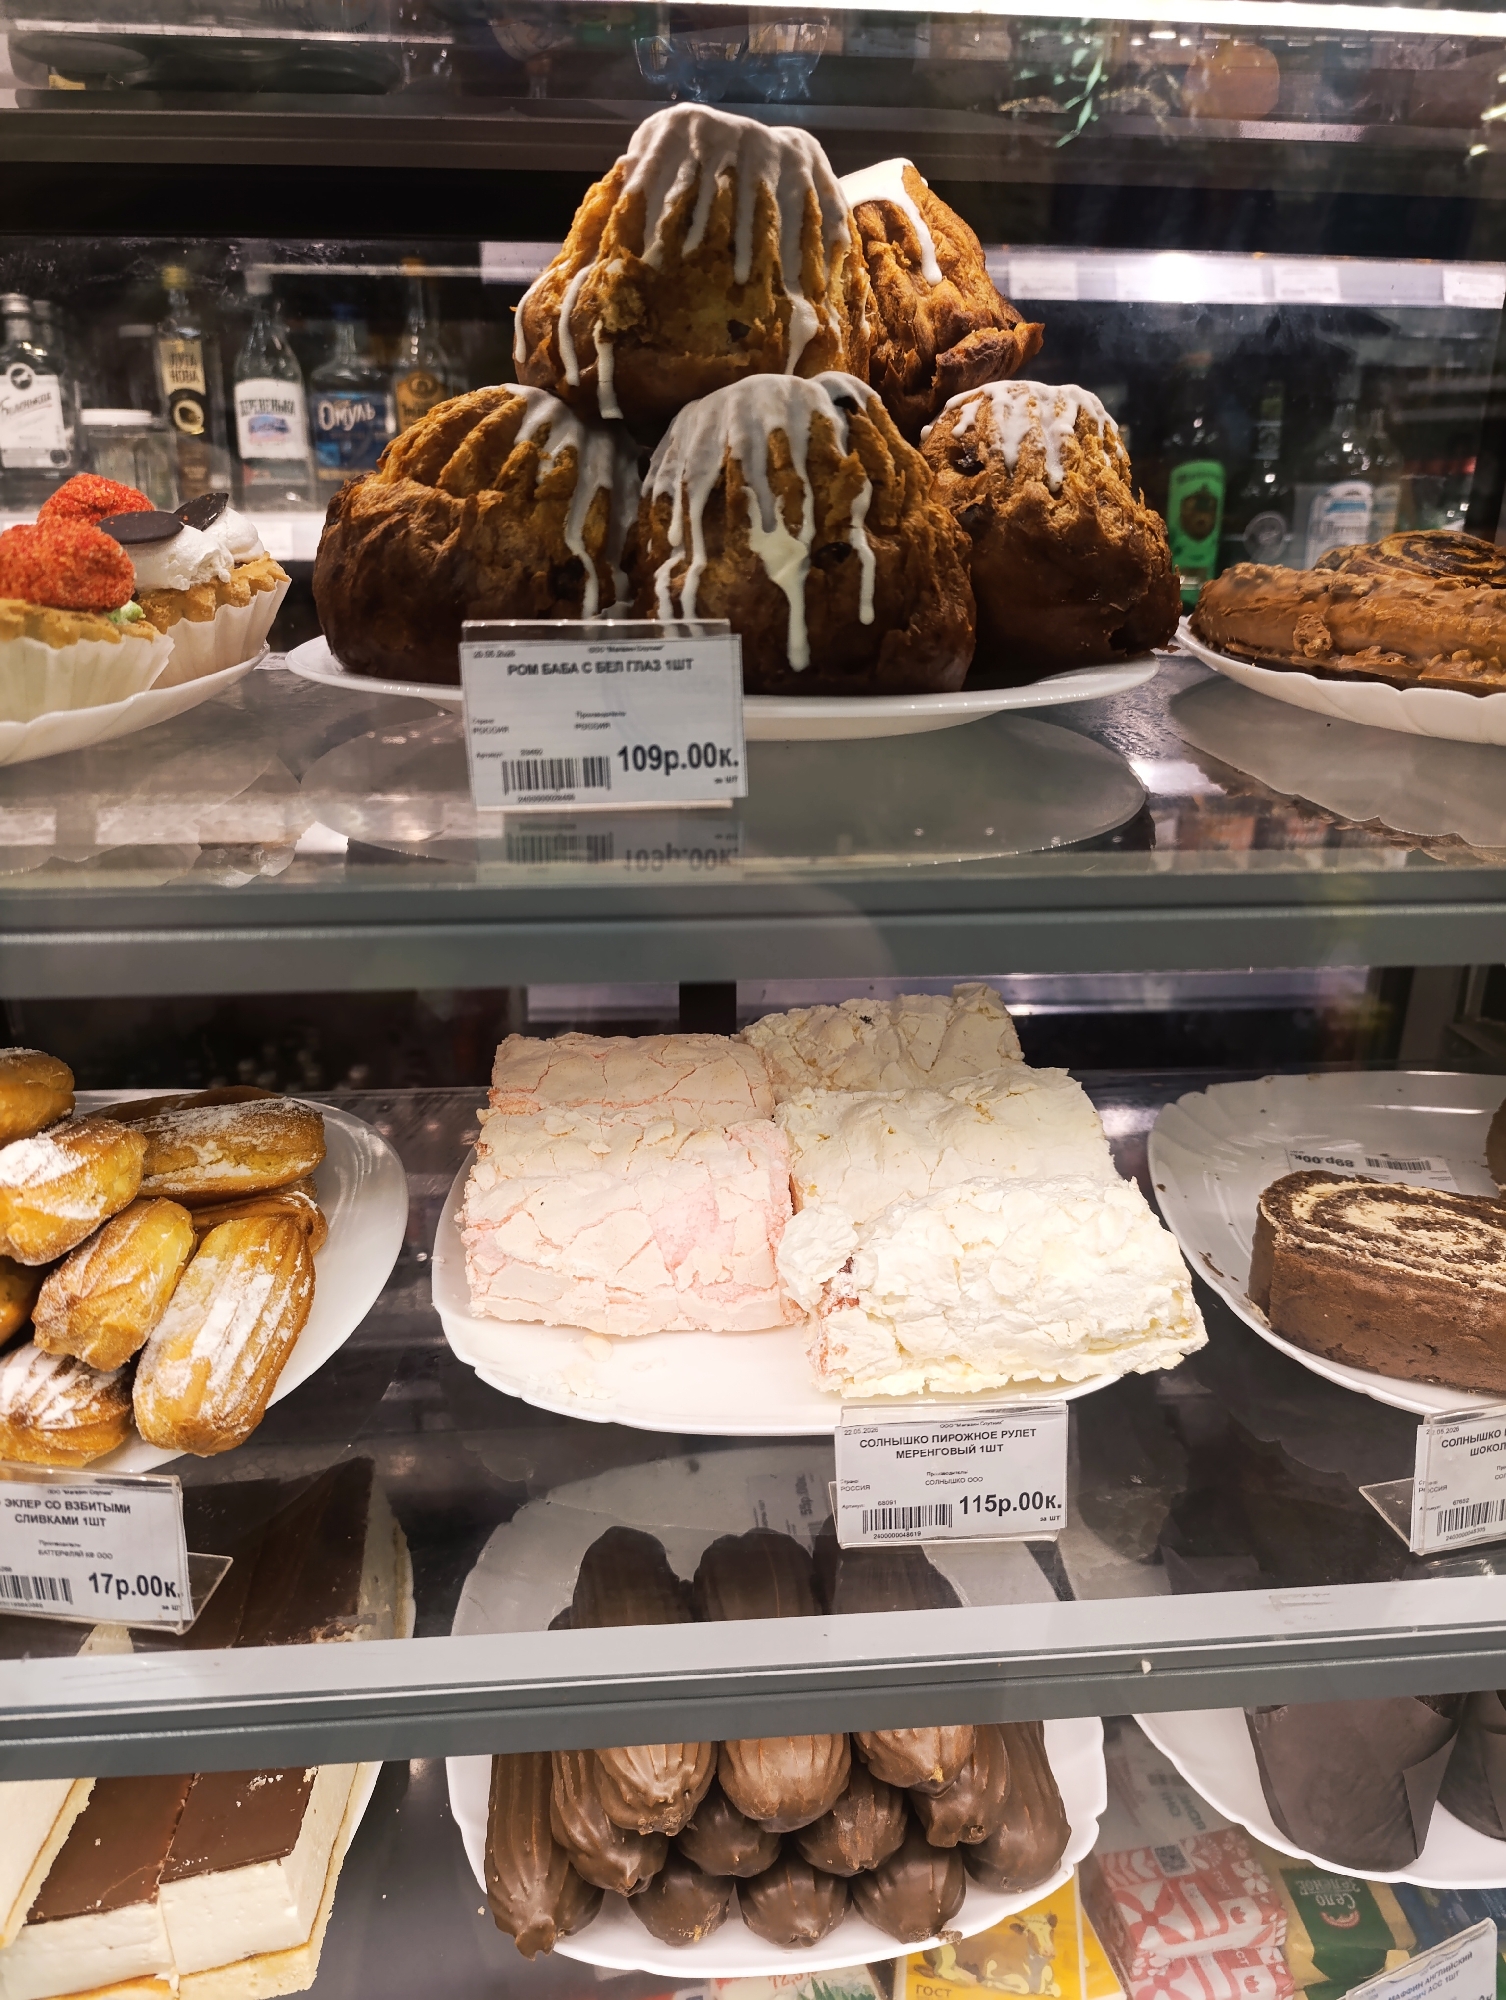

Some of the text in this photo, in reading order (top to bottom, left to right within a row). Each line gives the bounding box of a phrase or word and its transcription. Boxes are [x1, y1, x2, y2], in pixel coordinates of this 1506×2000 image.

[507, 659, 694, 676] РОМ БАБА С БЕЛ ГЛАЗ 1ШТ
[617, 742, 740, 775] 109р.00к.
[844, 1427, 878, 1436] 22.05.2026
[860, 1428, 1036, 1448] СОЛНЫШКО ПИРОЖНОЕ РУЛЕТ
[1442, 1429, 1502, 1448] СОЛНЫШКО
[896, 1444, 1004, 1459] МЕРЕНГОВЫЙ 1ШТ
[925, 1478, 966, 1486] СОЛНЫШКО
[4, 1498, 131, 1514] ЭКЛЕР СО ВЗБИТЫМИ
[960, 1490, 1062, 1516] 115р.00к.
[15, 1513, 107, 1527] СЛИВКАМИ 1ШТ
[88, 1572, 182, 1600] 17р.00к.
[1316, 1893, 1356, 1909] Село
[1425, 1951, 1473, 1984] АНГЛИЙСКИЙ
[915, 1984, 952, 1999] ГОСТ
[1428, 1980, 1443, 1994] АСС
